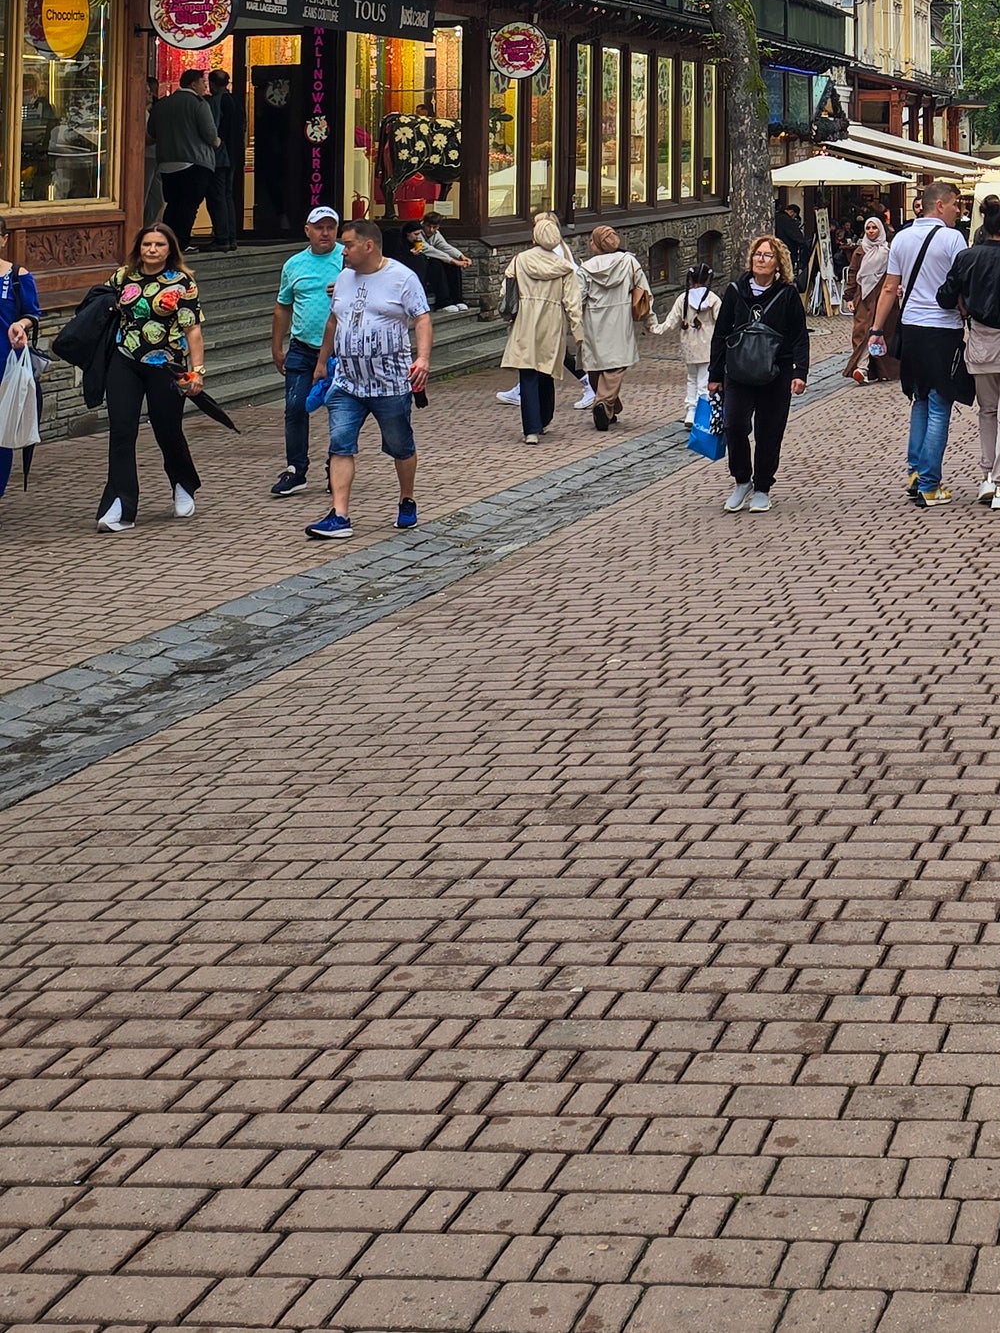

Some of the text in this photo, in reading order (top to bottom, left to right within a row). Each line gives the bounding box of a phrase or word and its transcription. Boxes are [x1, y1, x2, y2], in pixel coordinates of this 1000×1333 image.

[46, 9, 85, 21] Chocolate
[168, 3, 213, 15] Zakopane
[302, 6, 318, 19] JEANS
[354, 0, 387, 23] TOUS
[175, 12, 207, 26] Shop
[312, 26, 325, 114] MALINOWA
[310, 147, 323, 206] KRÓWK
